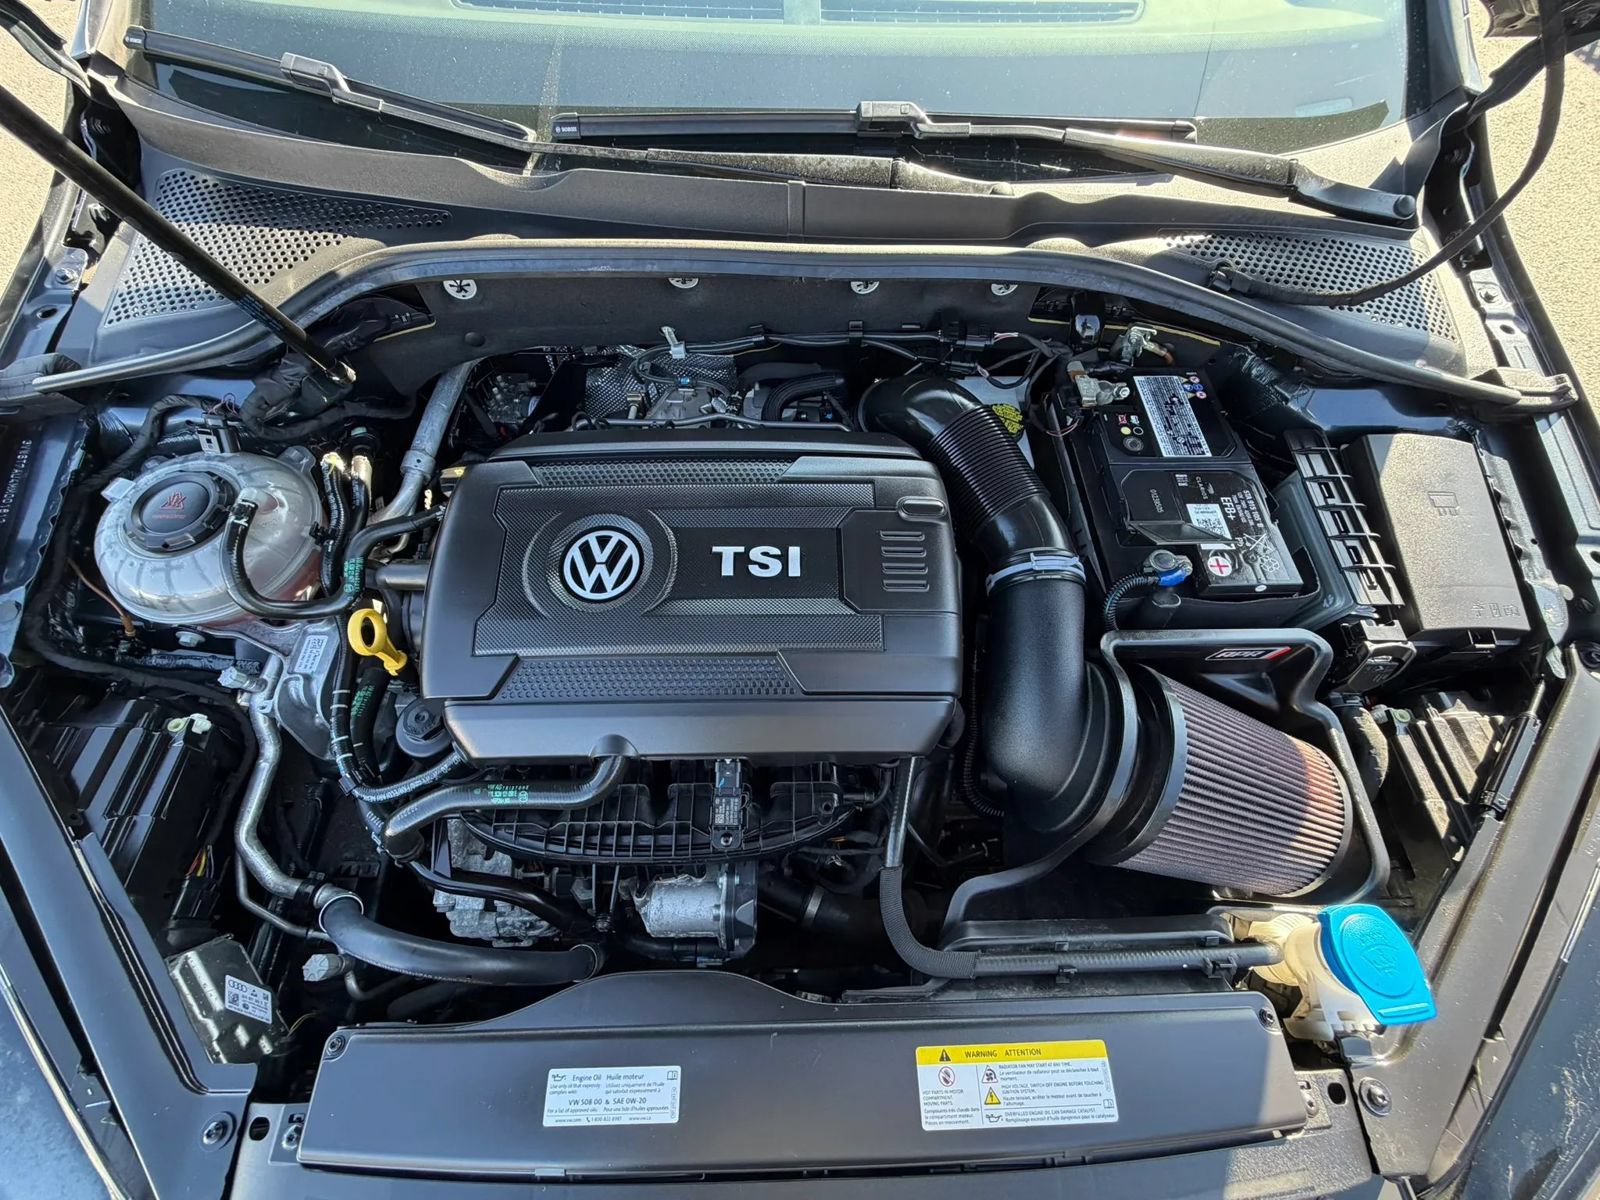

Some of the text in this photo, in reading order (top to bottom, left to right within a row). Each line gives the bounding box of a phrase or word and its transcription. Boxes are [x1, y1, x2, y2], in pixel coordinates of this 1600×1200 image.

[1220, 496, 1236, 521] EFB+
[563, 529, 640, 600] VW
[711, 545, 801, 578] TSI
[964, 1048, 1042, 1058] WARNING ATTENTION
[572, 1074, 592, 1082] Engine
